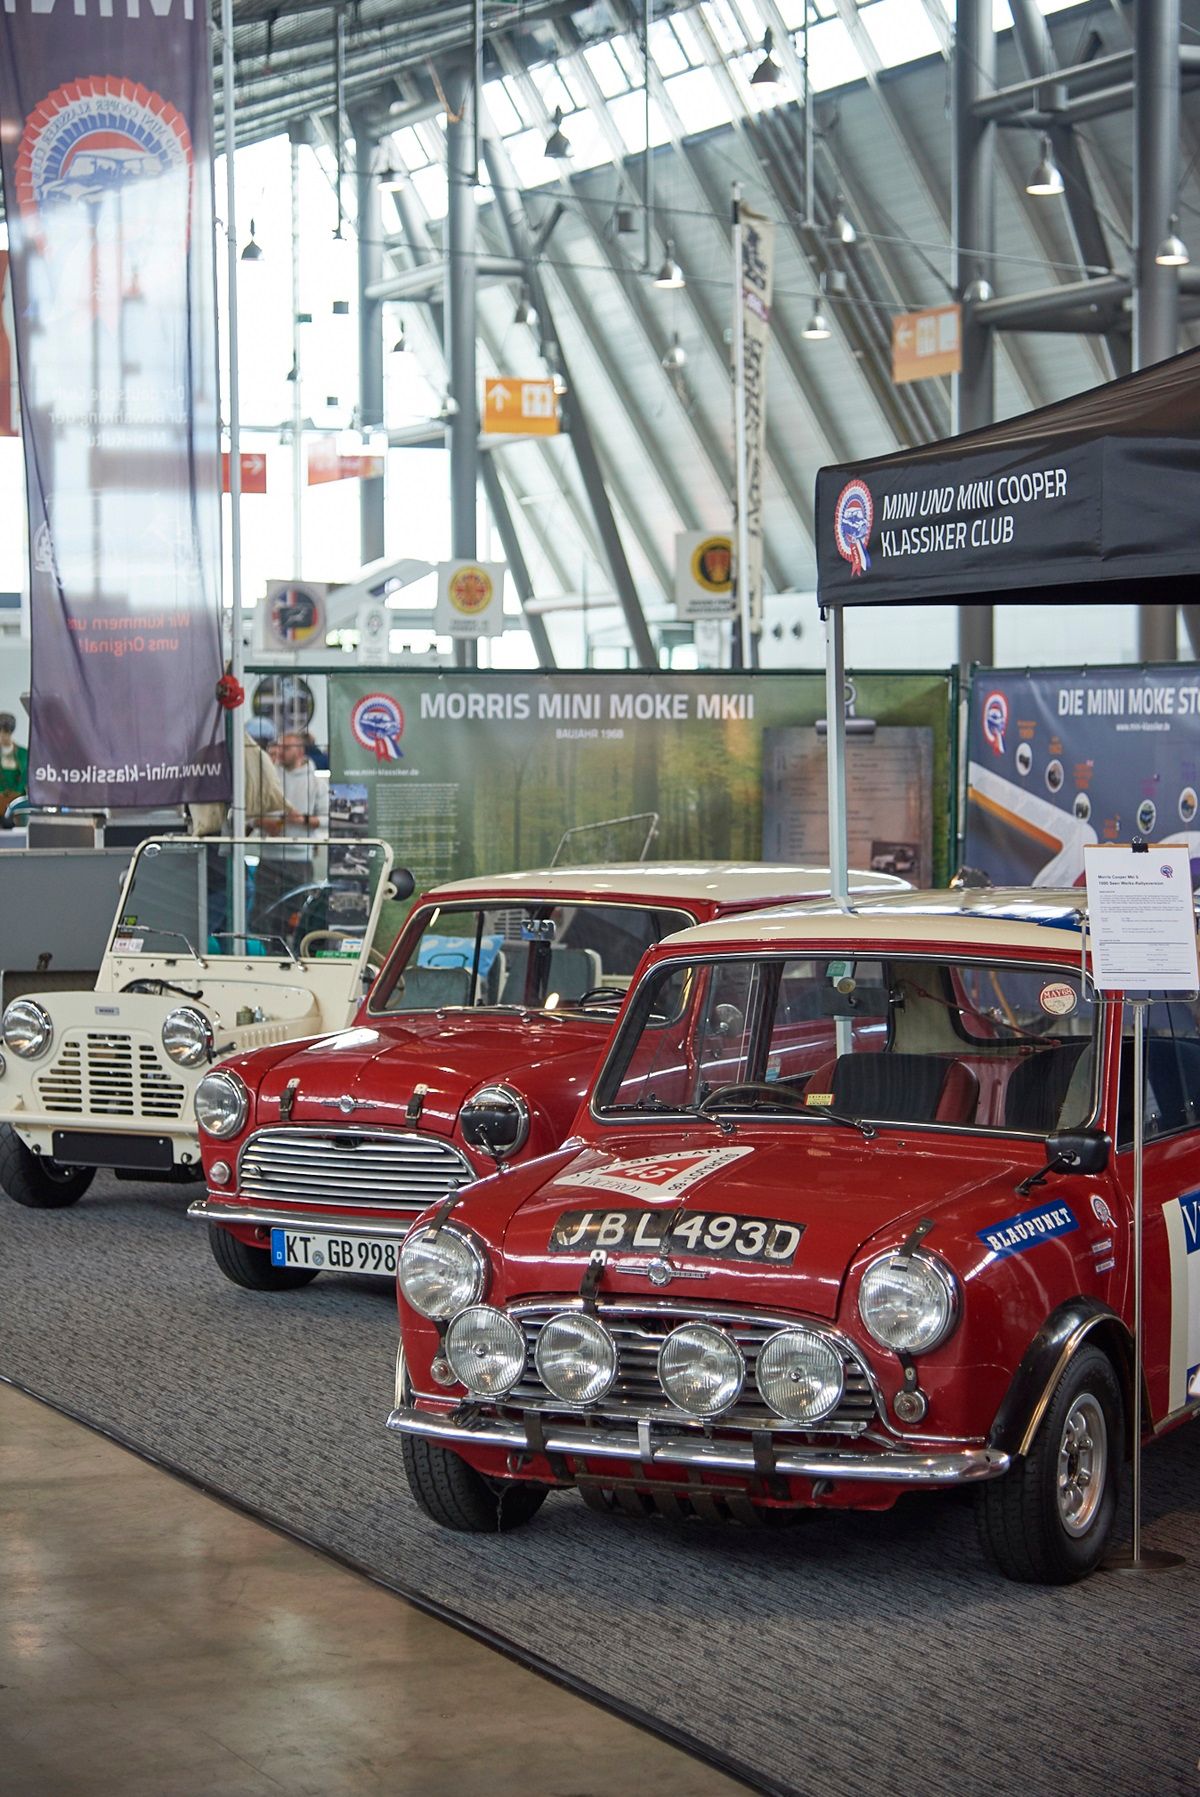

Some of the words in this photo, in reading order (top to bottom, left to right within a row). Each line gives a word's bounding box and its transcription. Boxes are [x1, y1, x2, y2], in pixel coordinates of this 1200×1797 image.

[882, 491, 918, 521] MINI
[920, 486, 955, 516] UND
[956, 479, 994, 511] MINI
[997, 468, 1068, 505] COOPER
[880, 522, 967, 558] KLASSIKER
[971, 515, 1014, 547] CLUB
[420, 692, 531, 719] MORRIS
[538, 693, 601, 719] MINI
[609, 693, 689, 719] MOKE
[697, 694, 755, 720] MKII
[1058, 689, 1085, 716] DIE
[1087, 688, 1125, 716] MINI
[1128, 687, 1176, 715] MOKE
[556, 728, 599, 740] BAUJAHR
[601, 728, 625, 740] 1968
[625, 1164, 680, 1179] 45
[673, 1215, 800, 1260] 493D
[986, 1207, 1072, 1251] BLAUPUNKT
[276, 1251, 283, 1260] D
[286, 1235, 312, 1264] KT
